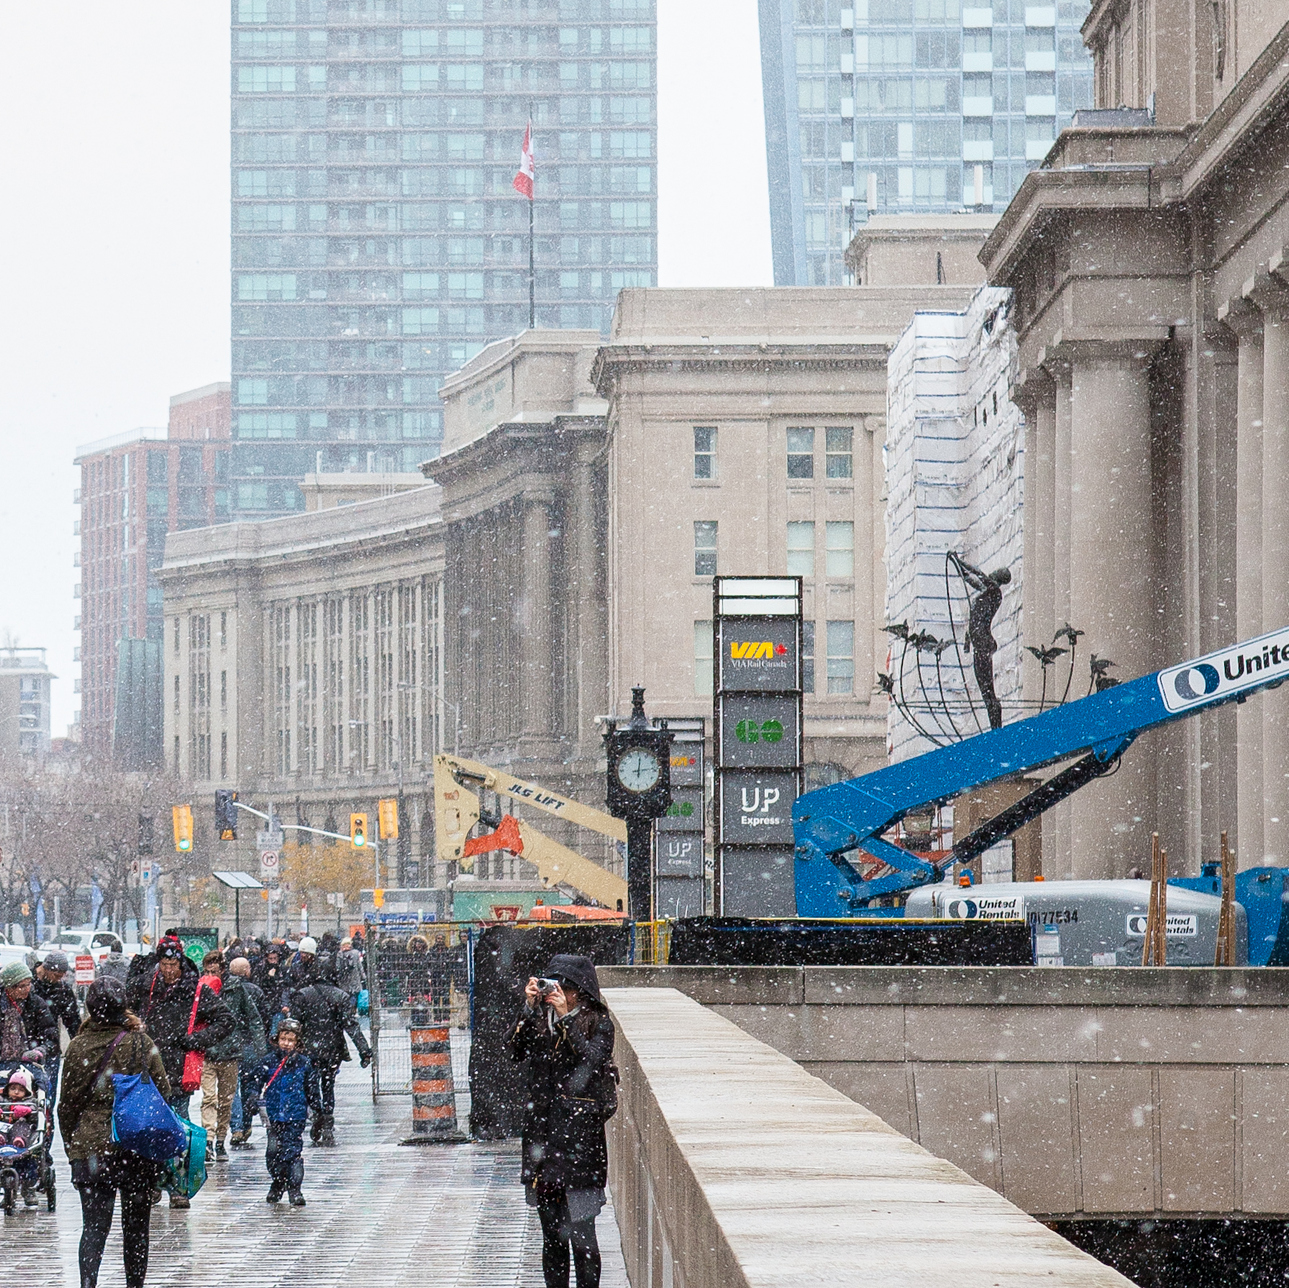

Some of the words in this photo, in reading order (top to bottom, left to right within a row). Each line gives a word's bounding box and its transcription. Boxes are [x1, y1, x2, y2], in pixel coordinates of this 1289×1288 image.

[730, 642, 774, 659] VIA
[731, 659, 746, 669] VIA
[735, 719, 783, 743] GO
[508, 784, 533, 798] JLG
[533, 792, 565, 810] LIFT
[741, 787, 780, 812] UP
[741, 815, 780, 827] Express
[668, 842, 692, 858] UP
[978, 898, 1017, 910] United
[978, 910, 1020, 919] Rentals
